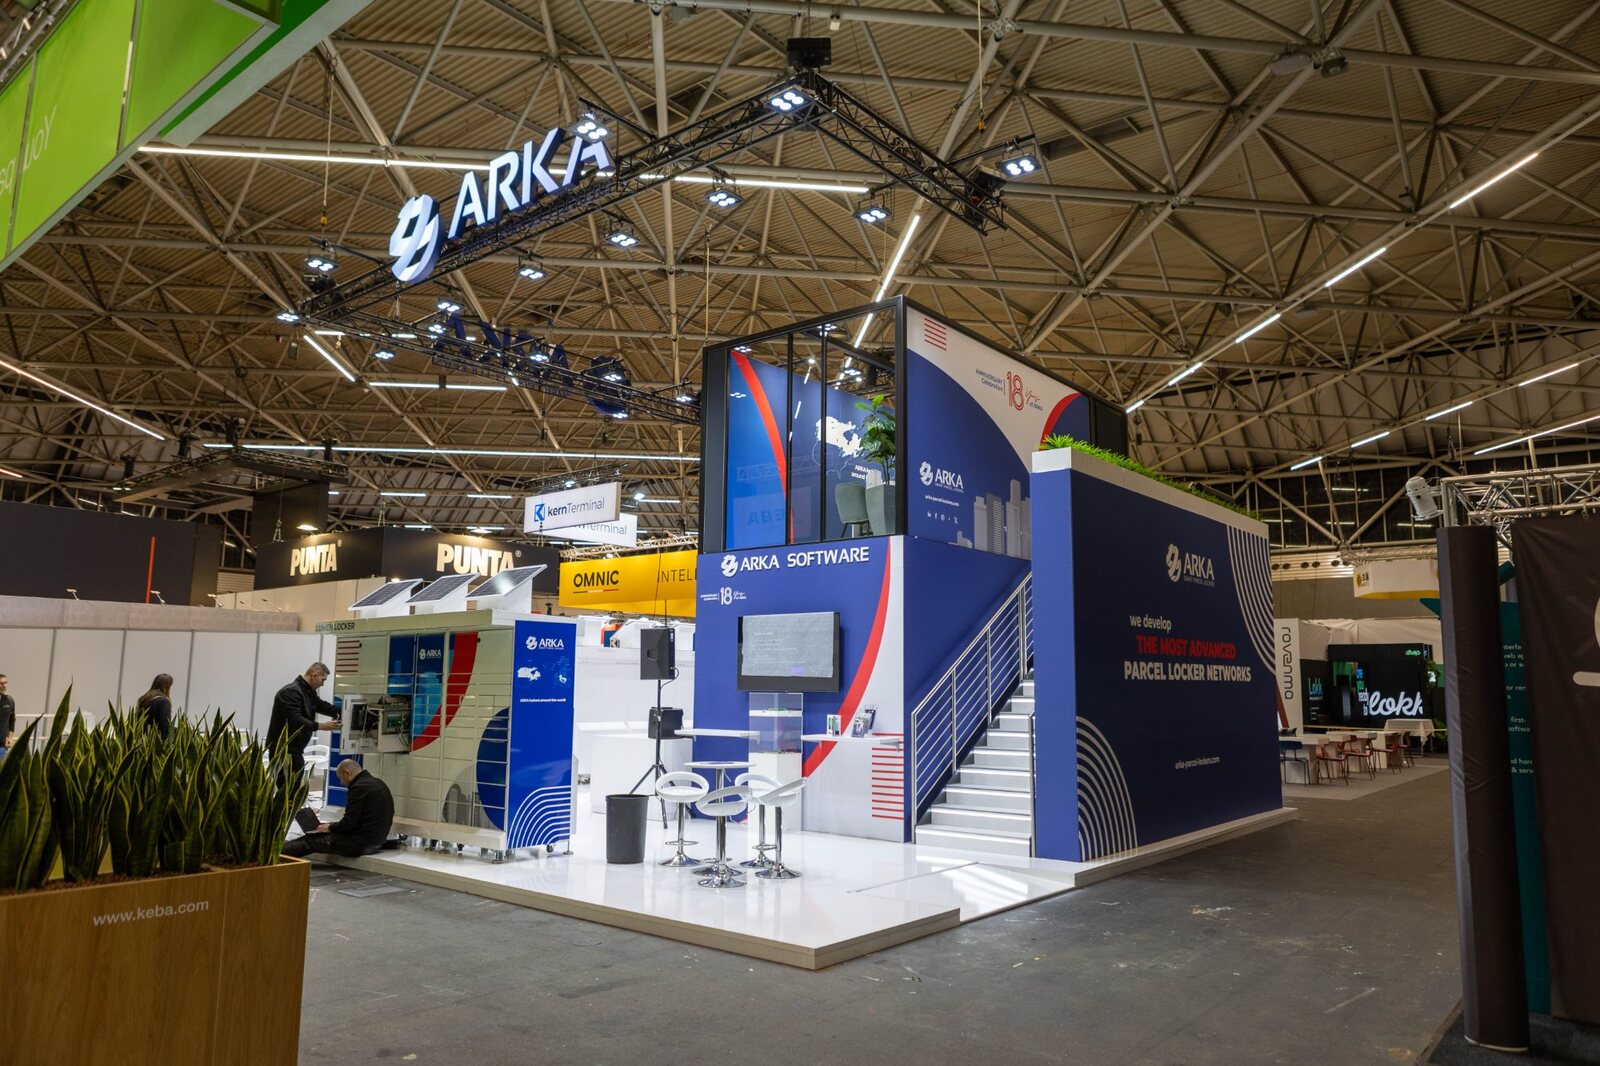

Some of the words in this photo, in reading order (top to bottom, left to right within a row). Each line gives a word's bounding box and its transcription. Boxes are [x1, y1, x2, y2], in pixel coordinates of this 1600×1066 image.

[447, 127, 615, 240] ARKA
[1007, 371, 1024, 411] 18
[935, 468, 964, 489] ARKA
[547, 498, 605, 517] kernTerminal
[740, 554, 780, 572] ARKA
[787, 546, 870, 568] SOFTWARE
[1183, 552, 1215, 580] ARKA
[573, 570, 619, 587] OMNIC
[720, 587, 733, 605] 18
[334, 622, 355, 631] LOCKER
[1130, 615, 1141, 627] we
[1143, 613, 1172, 633] develop
[426, 649, 442, 657] ARKA
[539, 638, 565, 648] ARKA
[1136, 634, 1157, 654] THE
[1160, 637, 1187, 656] MOST
[1190, 640, 1236, 660] ADVANCED
[1124, 660, 1167, 681] PARCEL
[1168, 662, 1205, 681] LOCKER
[1206, 664, 1252, 682] NETWORKS
[93, 900, 210, 927] www.keba.com
